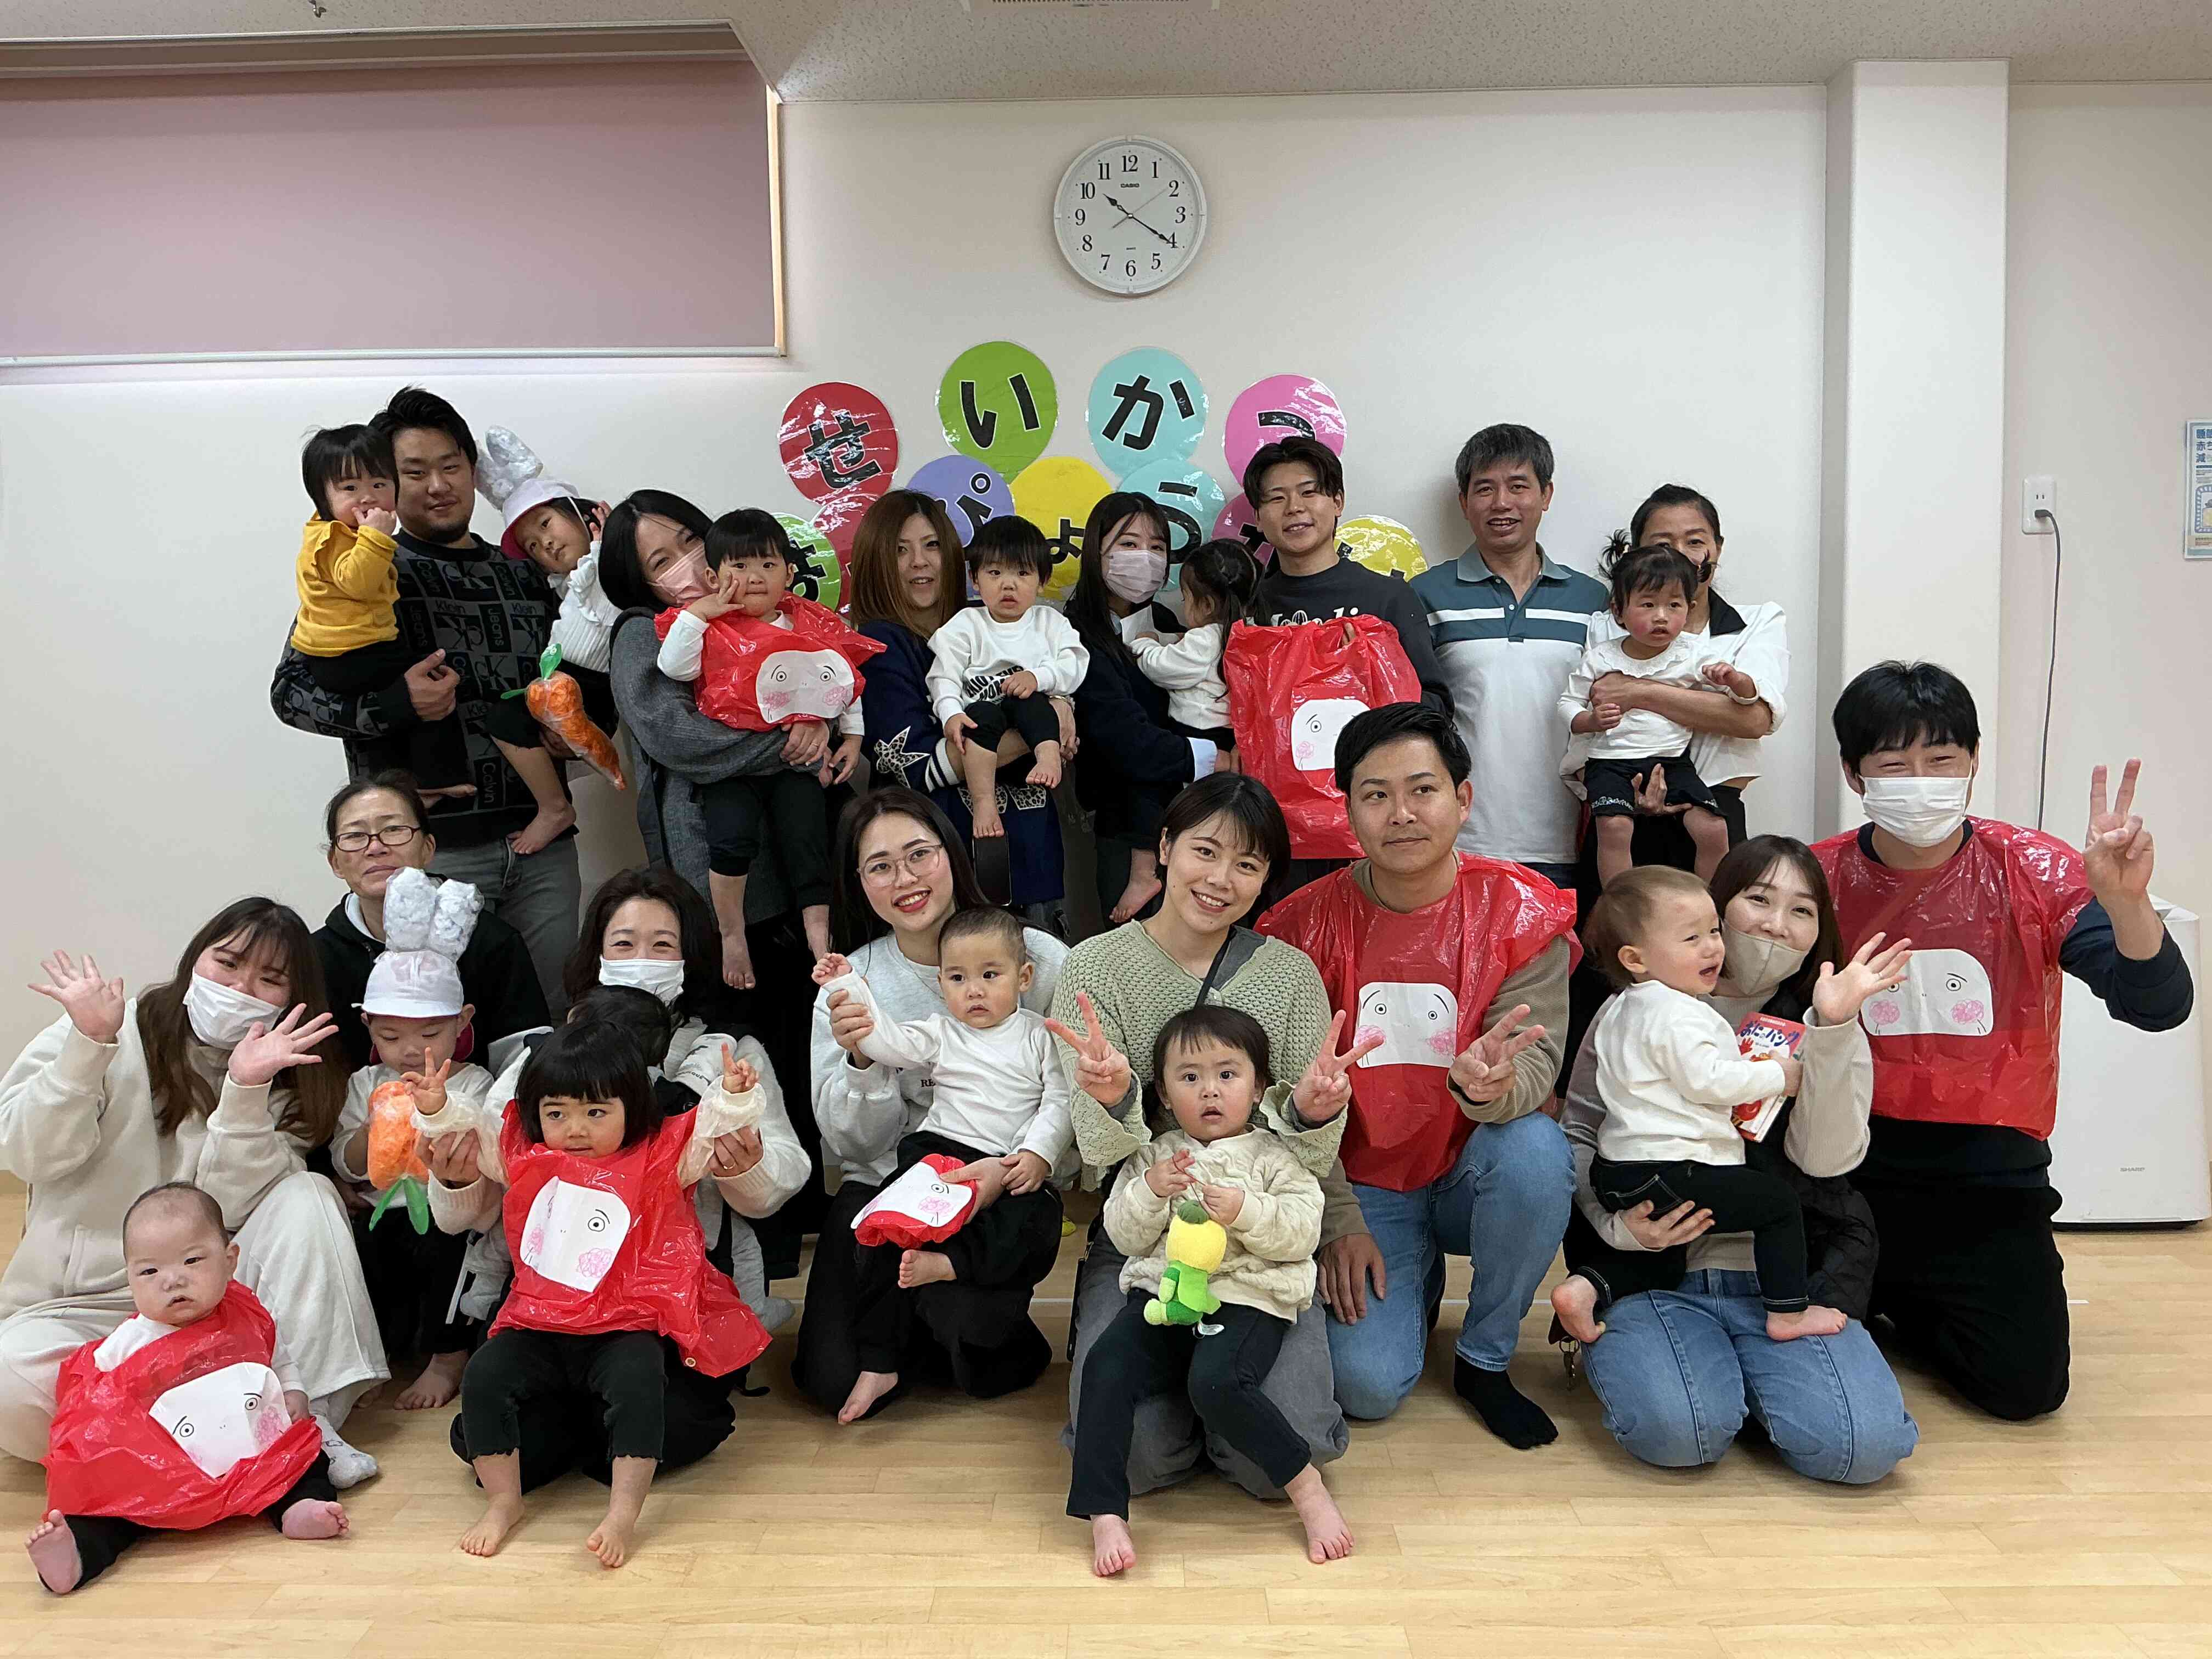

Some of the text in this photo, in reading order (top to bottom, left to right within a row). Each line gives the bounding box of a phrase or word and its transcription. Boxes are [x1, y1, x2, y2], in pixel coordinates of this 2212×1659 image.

[1098, 162, 1111, 180] 11
[1121, 155, 1138, 172] 12
[1152, 161, 1159, 178] 1
[1080, 182, 1096, 199] 10
[1169, 180, 1180, 197] 2
[1075, 209, 1086, 225] 9
[1175, 206, 1186, 223] 3
[1082, 234, 1093, 252] 8
[1166, 232, 1177, 249] 4
[1101, 254, 1110, 270] 7
[1125, 259, 1137, 276] 6
[1151, 253, 1161, 269] 5
